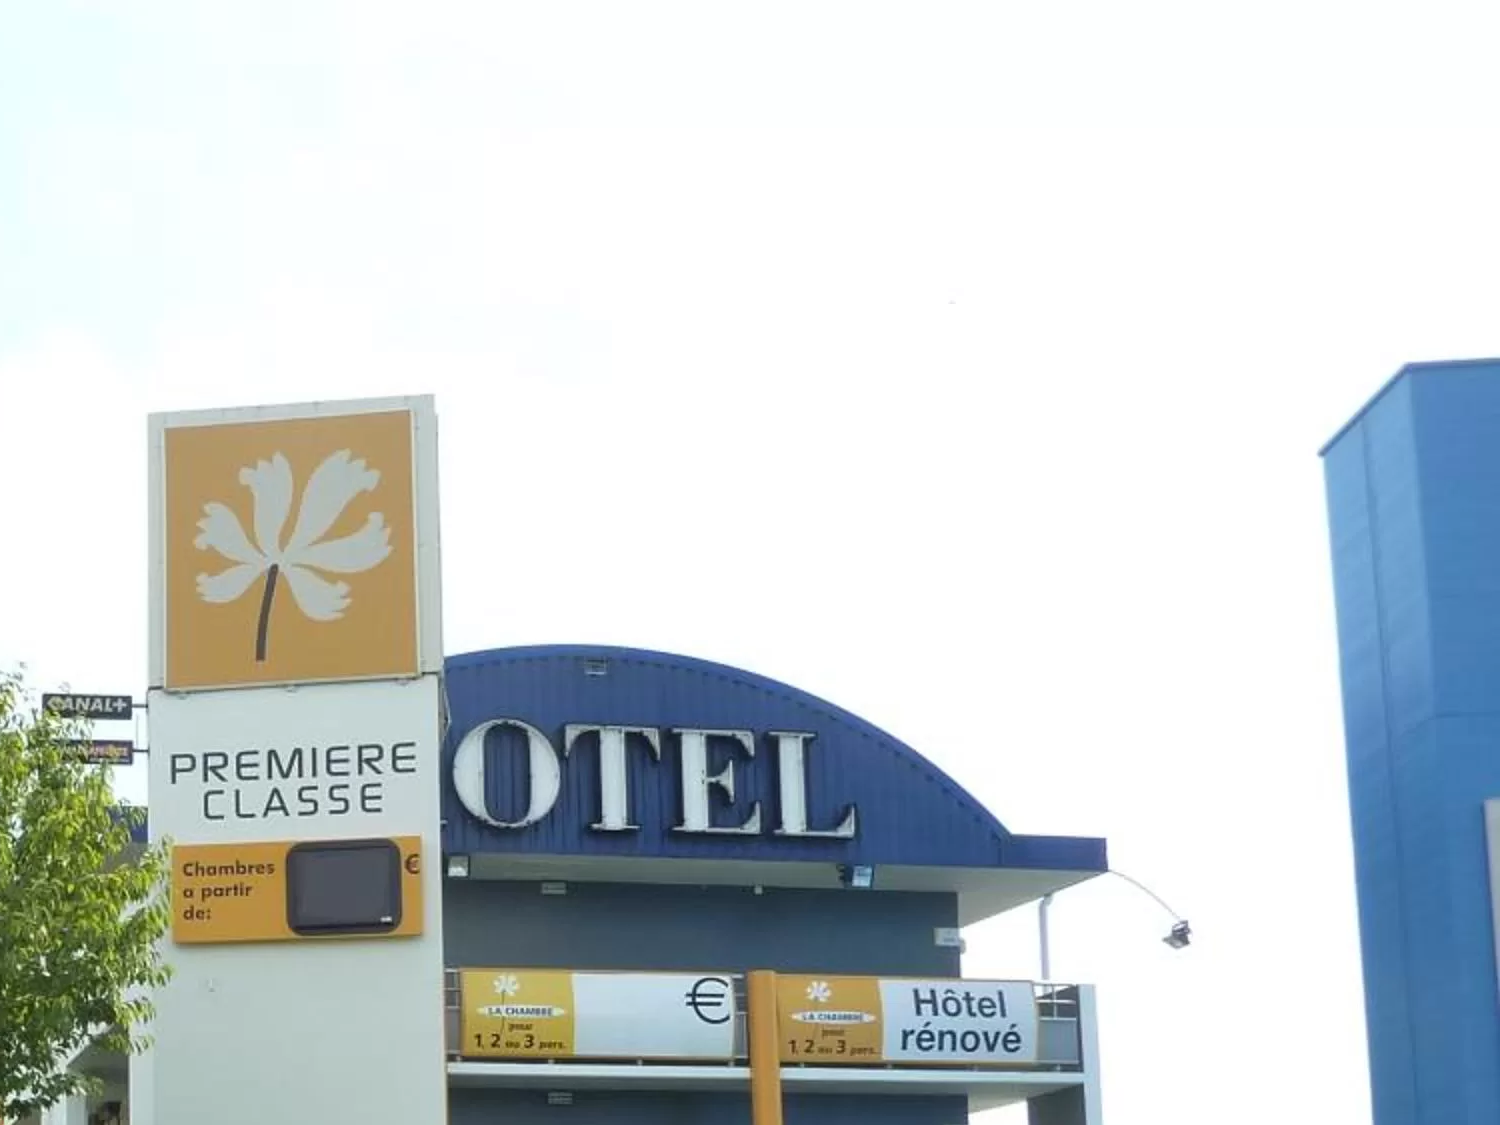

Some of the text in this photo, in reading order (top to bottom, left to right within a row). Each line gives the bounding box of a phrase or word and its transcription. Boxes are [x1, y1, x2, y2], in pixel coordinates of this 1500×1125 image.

[170, 741, 417, 784] PREMIERE
[441, 718, 856, 838] OTEL
[203, 783, 383, 820] CLASSE
[182, 861, 276, 877] Chambres
[183, 883, 253, 902] a partir
[183, 905, 212, 921] de:
[505, 1007, 553, 1016] CHAMBRE
[686, 977, 731, 1025] €
[912, 987, 1008, 1018] Hôtel
[491, 1033, 501, 1048] 2
[523, 1033, 534, 1049] 3
[803, 1039, 814, 1054] 2
[836, 1039, 846, 1054] 3
[901, 1021, 1022, 1053] rénové
